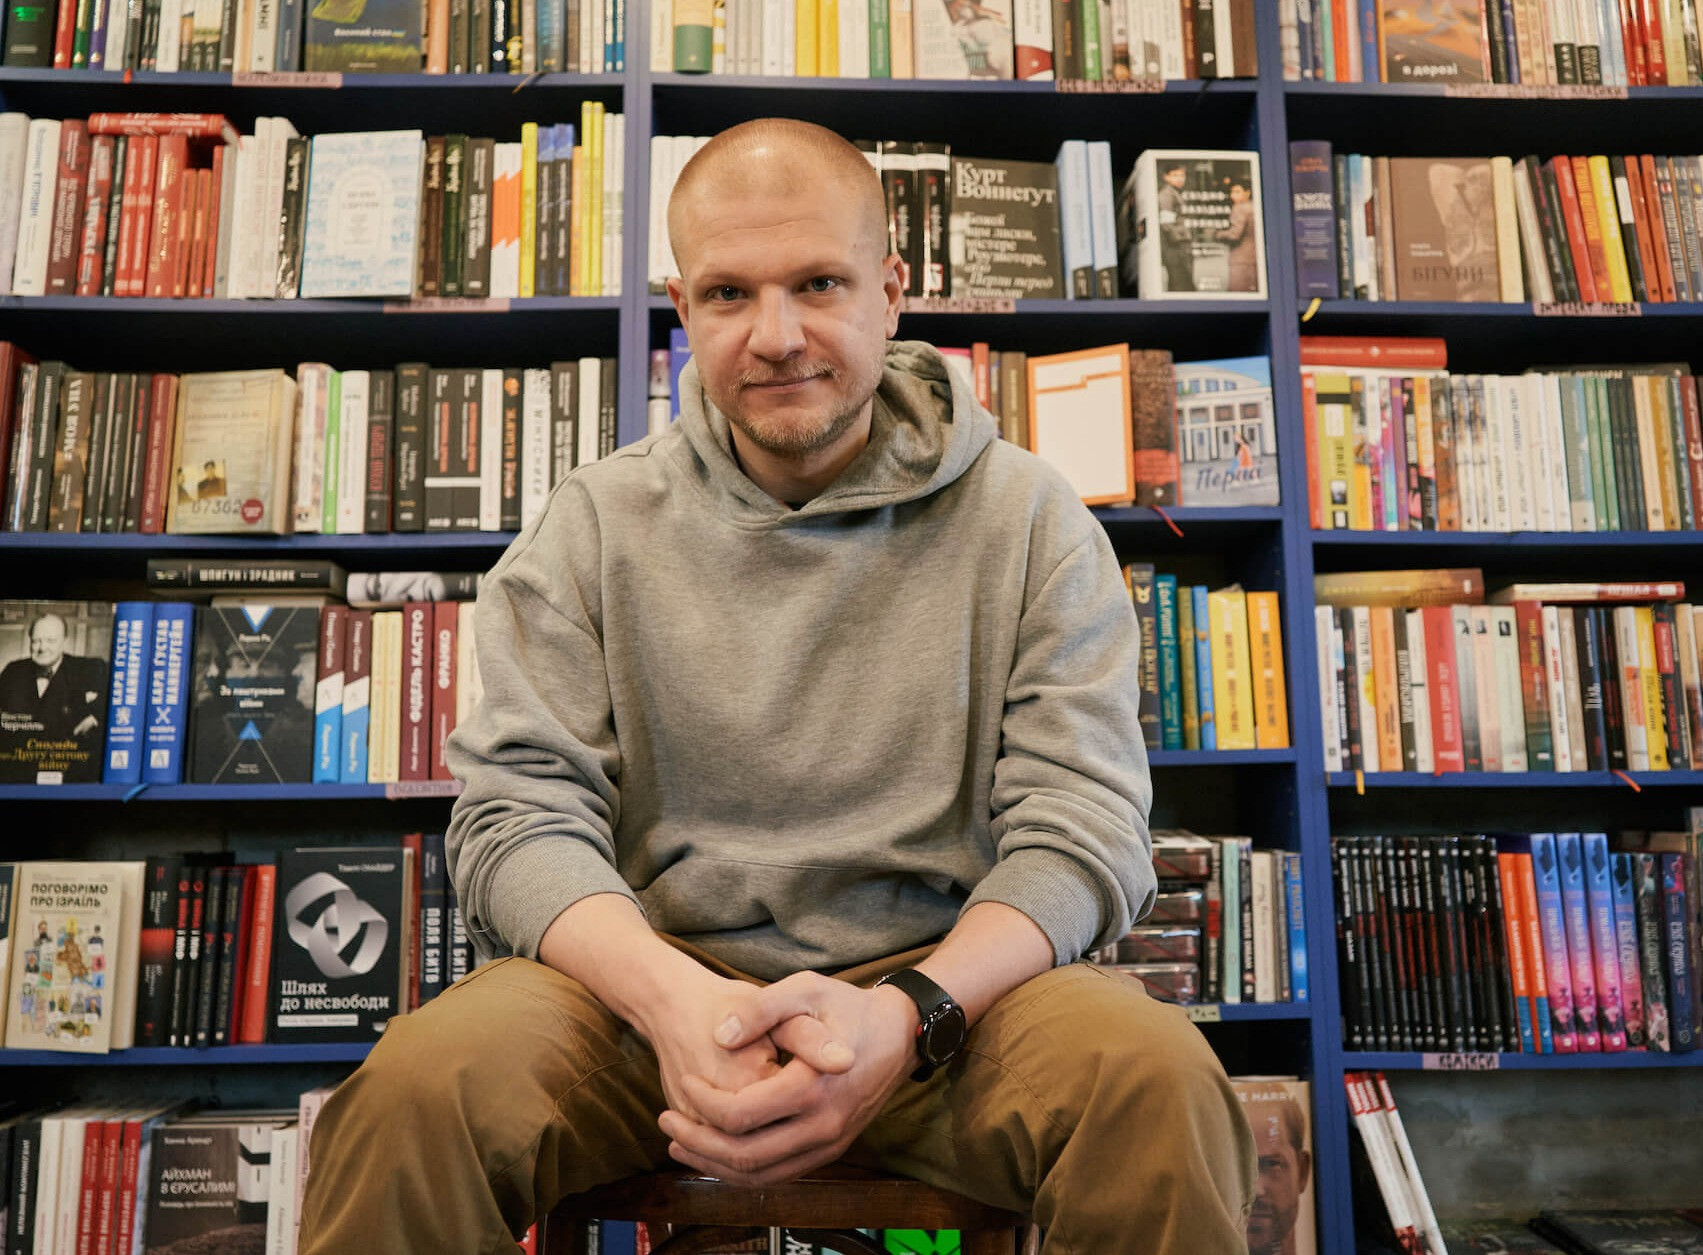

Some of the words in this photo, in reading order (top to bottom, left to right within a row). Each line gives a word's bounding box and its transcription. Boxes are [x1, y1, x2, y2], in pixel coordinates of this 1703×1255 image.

[1413, 62, 1458, 77] дорозі
[956, 162, 1007, 187] Курт
[956, 182, 1056, 207] Воннегут
[1412, 266, 1482, 282] БІГУНИ
[200, 569, 241, 582] ШПИГУН
[249, 569, 295, 582] ЗРАДНИК
[411, 610, 424, 667] КАСТРО
[125, 620, 143, 706] МАННЕРГЕЙМ
[166, 619, 184, 705] МАННЕРГЕЙМ
[438, 629, 451, 689] ФРАНКО
[112, 671, 123, 705] КАРЛ
[152, 670, 165, 705] КАРЛ
[409, 667, 423, 723] ФІДЕЛЬ
[30, 896, 53, 906] ПРО
[56, 895, 101, 907] ІЗРАЇЛЬ
[31, 883, 109, 894] ПОГОВОРІМО
[426, 907, 440, 944] ПОЛЯ
[425, 948, 439, 984] БИТВ
[281, 980, 327, 995] Шлях
[280, 998, 300, 1012] до
[304, 993, 390, 1011] несвободи
[1438, 1054, 1495, 1069] КОМІКСИ
[161, 1168, 212, 1181] АЙХМАН
[160, 1182, 168, 1194] В
[170, 1182, 235, 1194] ЄРУСАЛИМІ
